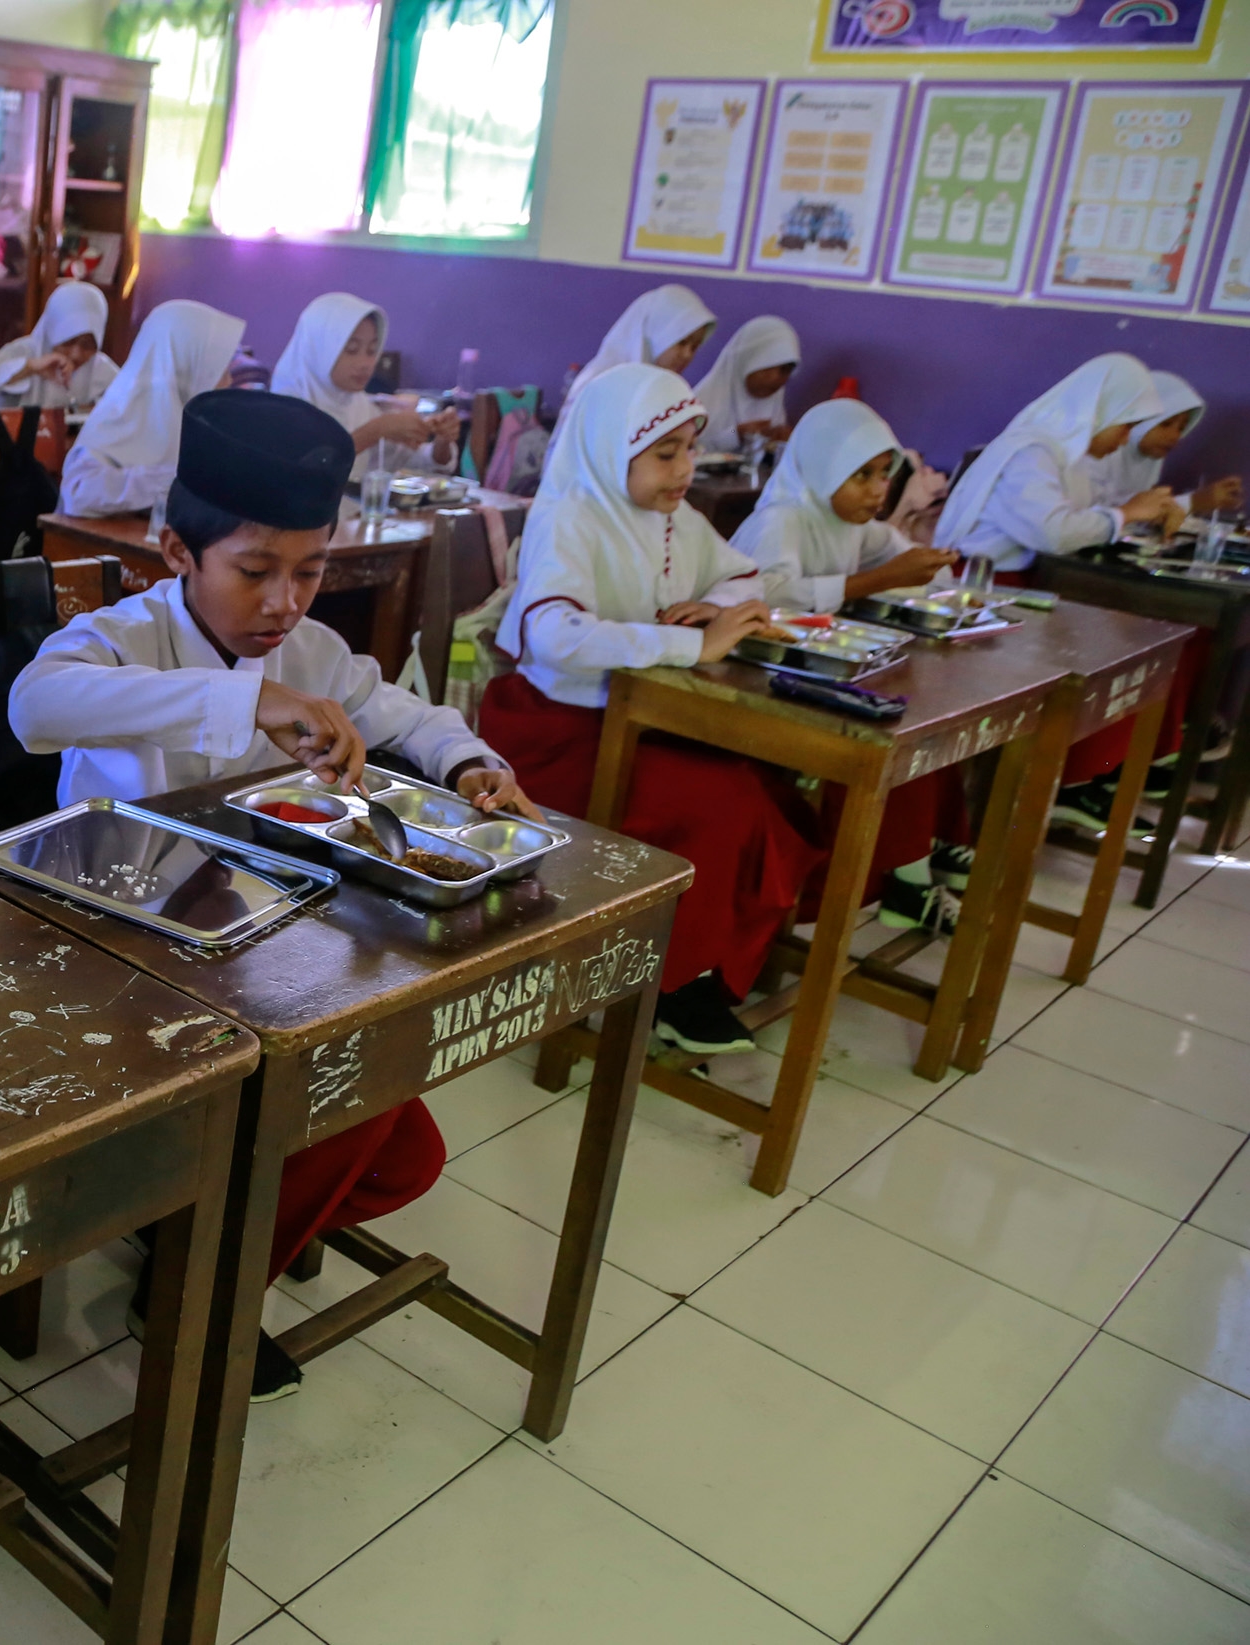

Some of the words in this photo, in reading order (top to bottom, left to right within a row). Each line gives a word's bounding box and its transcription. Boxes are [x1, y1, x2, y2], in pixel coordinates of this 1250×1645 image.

[425, 1028, 490, 1082] APBN
[495, 1004, 546, 1049] 2013
[428, 988, 486, 1047] MIN
[488, 961, 555, 1020] SASA
